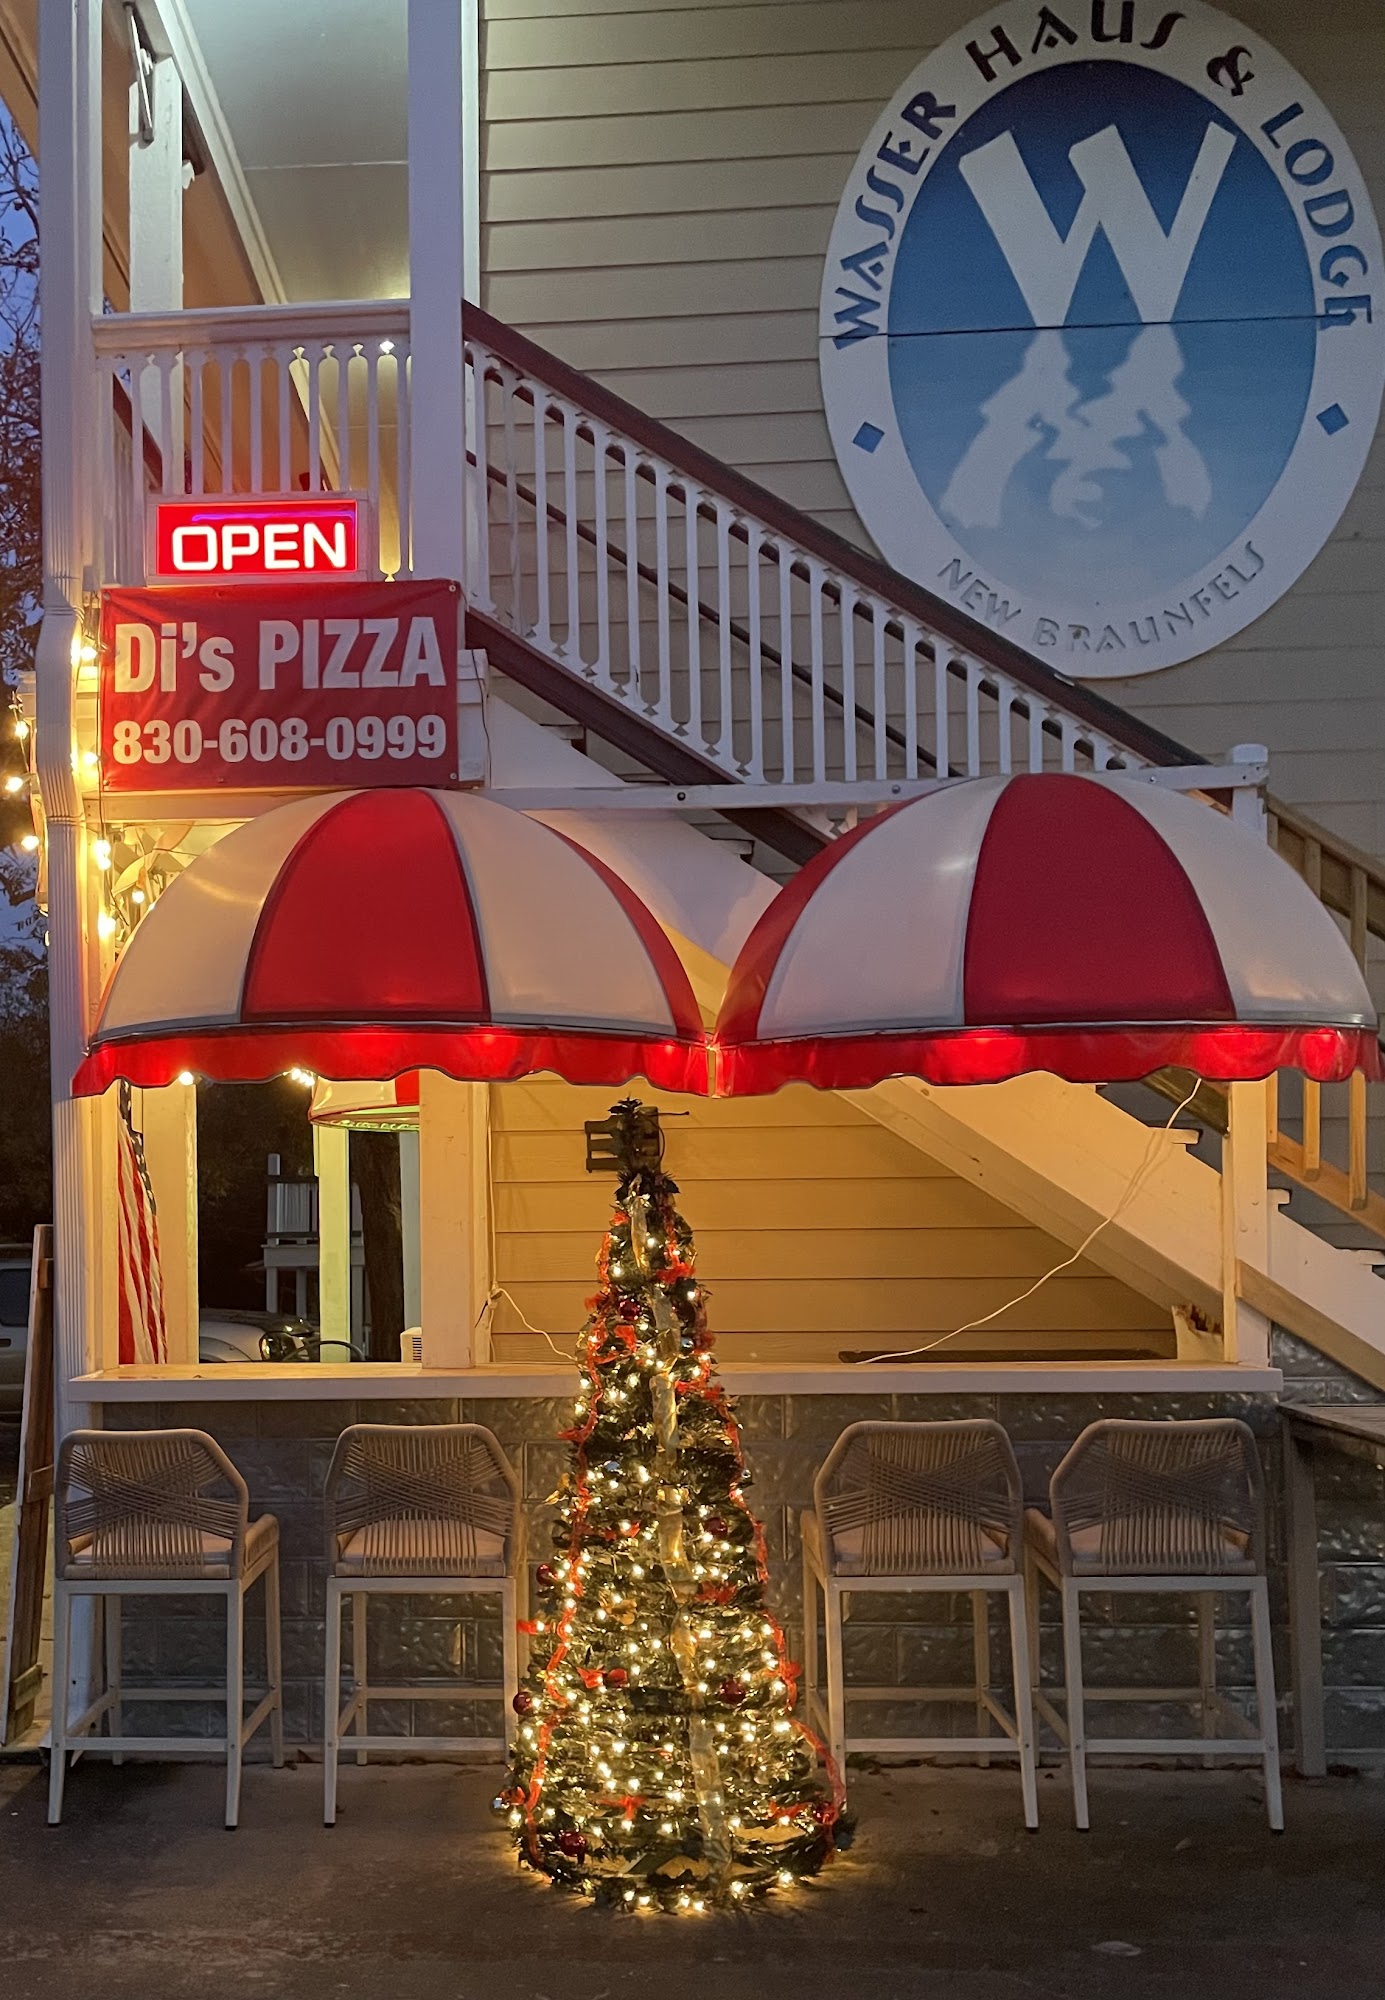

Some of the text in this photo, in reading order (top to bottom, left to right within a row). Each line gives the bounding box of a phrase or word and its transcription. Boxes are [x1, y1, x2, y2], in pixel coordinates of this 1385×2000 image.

[832, 0, 1372, 350] WASSER HAUS & LODGE
[958, 121, 1238, 328] W
[172, 522, 347, 571] OPEN
[937, 540, 1266, 654] NEW BRAUNFELS
[114, 616, 446, 694] Di's PIZZA
[113, 715, 446, 765] 830-608-0999
